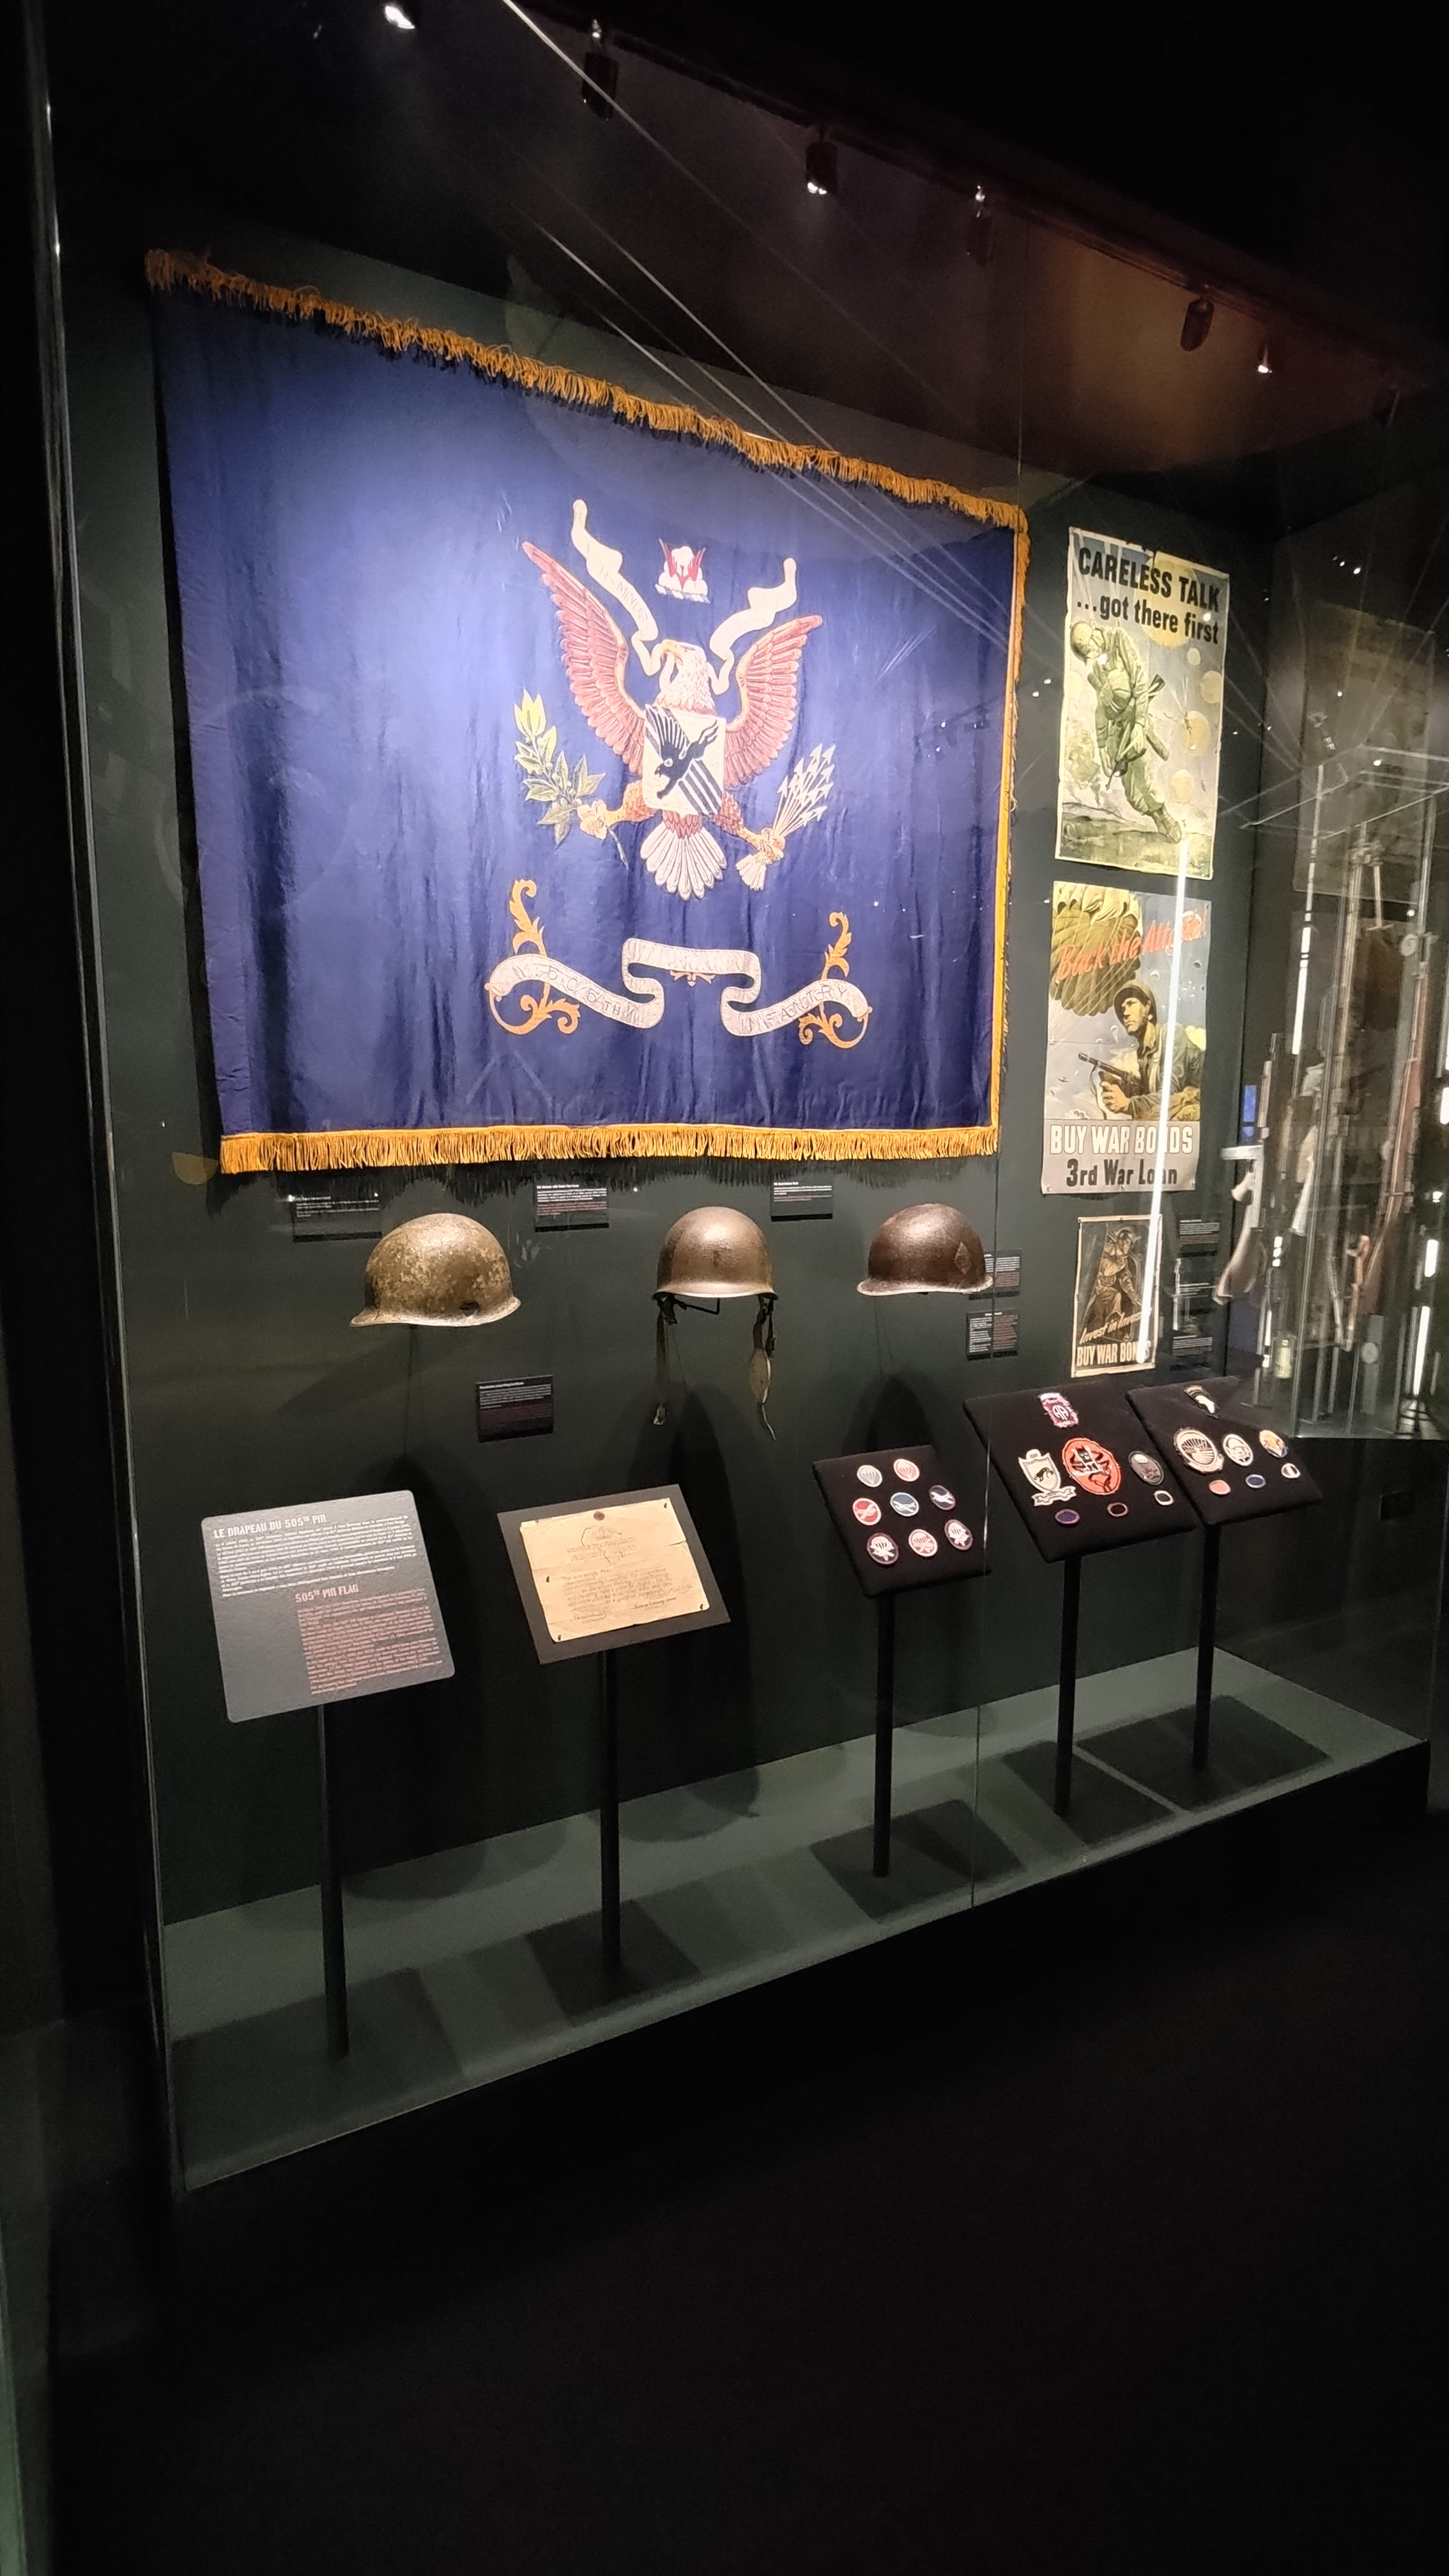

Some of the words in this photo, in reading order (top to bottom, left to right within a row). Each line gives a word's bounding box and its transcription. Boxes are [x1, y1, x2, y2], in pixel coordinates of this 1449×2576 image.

[1078, 548, 1172, 598] CARELESS
[1179, 576, 1220, 613] TALK
[1135, 599, 1178, 633] there
[1184, 612, 1219, 645] first
[1055, 936, 1107, 981] Back
[1109, 928, 1141, 965] the
[1050, 1124, 1087, 1155] BUY
[1091, 1124, 1131, 1154] WAR
[1134, 1125, 1193, 1154] BODS
[1066, 1158, 1098, 1187] 3rd
[1103, 1158, 1134, 1186] War
[1077, 1345, 1096, 1367] BUY
[1097, 1343, 1118, 1365] WAR
[1120, 1340, 1151, 1363] BONS
[213, 1529, 225, 1539] LE
[227, 1521, 268, 1537] DRAPEAU
[268, 1519, 282, 1531] DU
[312, 1514, 327, 1524] PIR
[322, 1587, 337, 1598] PIR
[338, 1583, 360, 1596] FLAG
